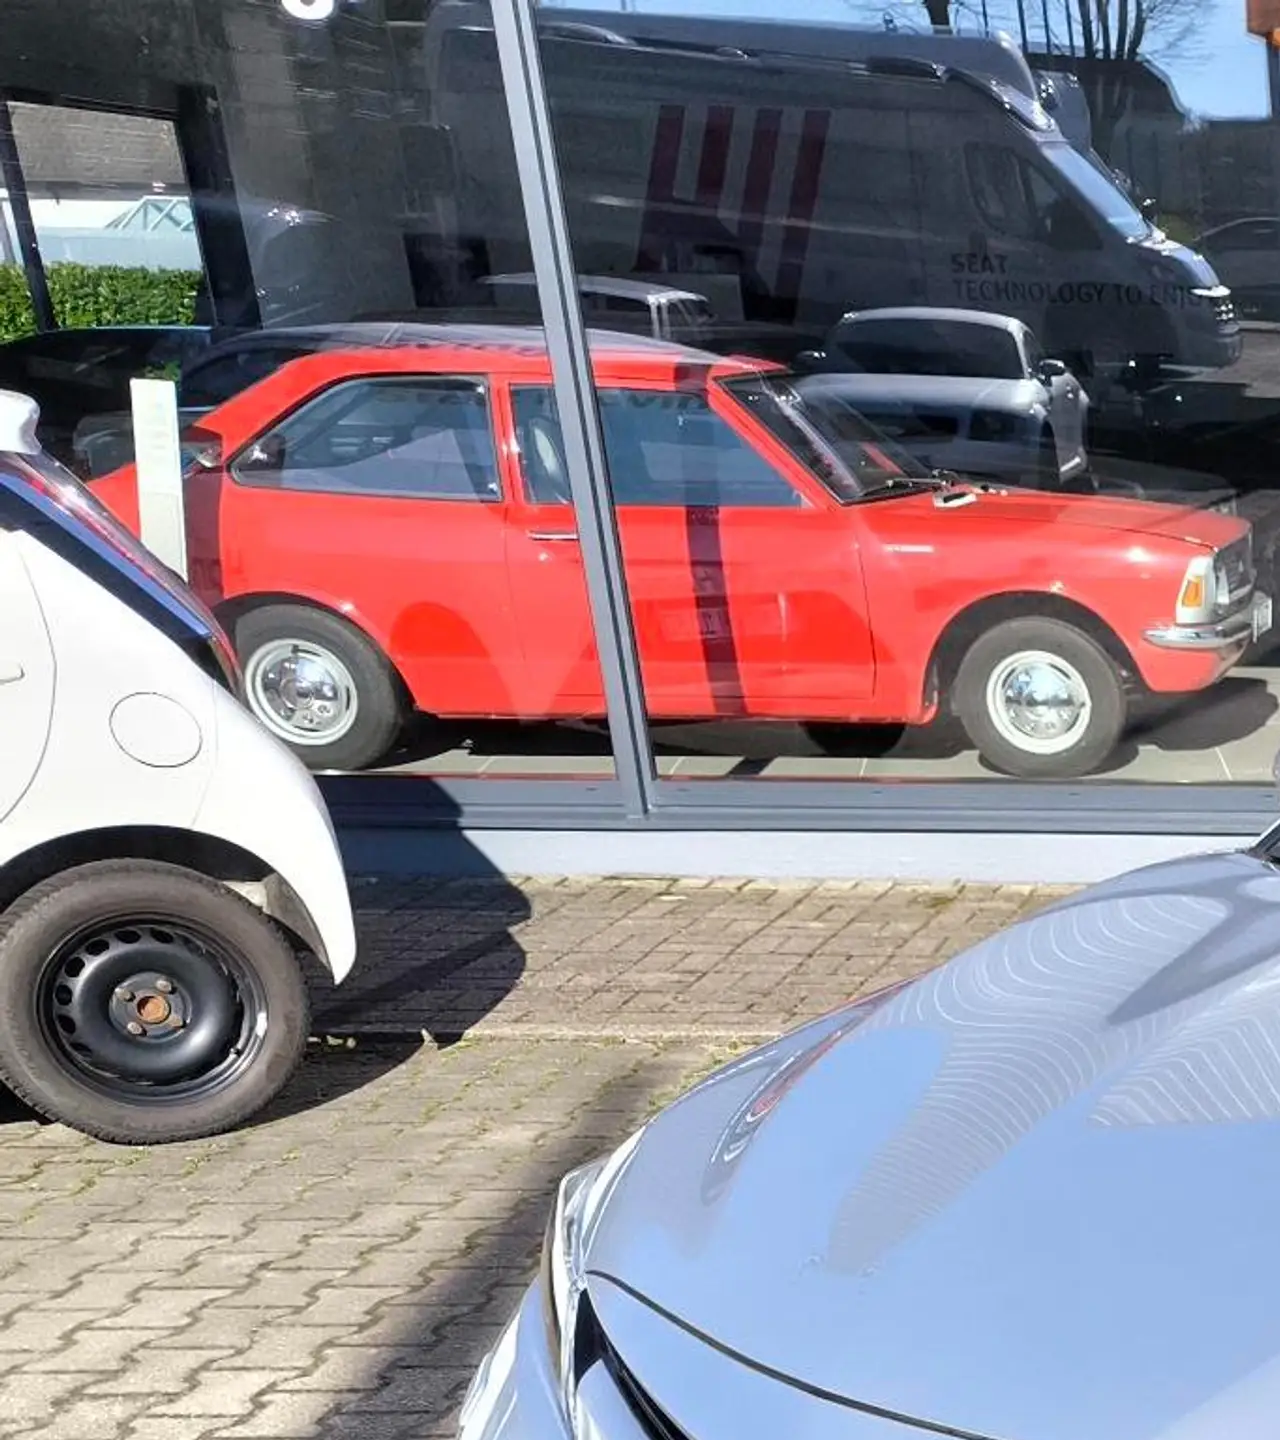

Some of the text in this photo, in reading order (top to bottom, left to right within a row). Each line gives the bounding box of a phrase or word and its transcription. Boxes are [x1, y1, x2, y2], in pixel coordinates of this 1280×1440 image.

[951, 253, 1007, 274] SEAT
[953, 278, 1112, 302] TECHNOLOGY
[1114, 282, 1141, 303] TO
